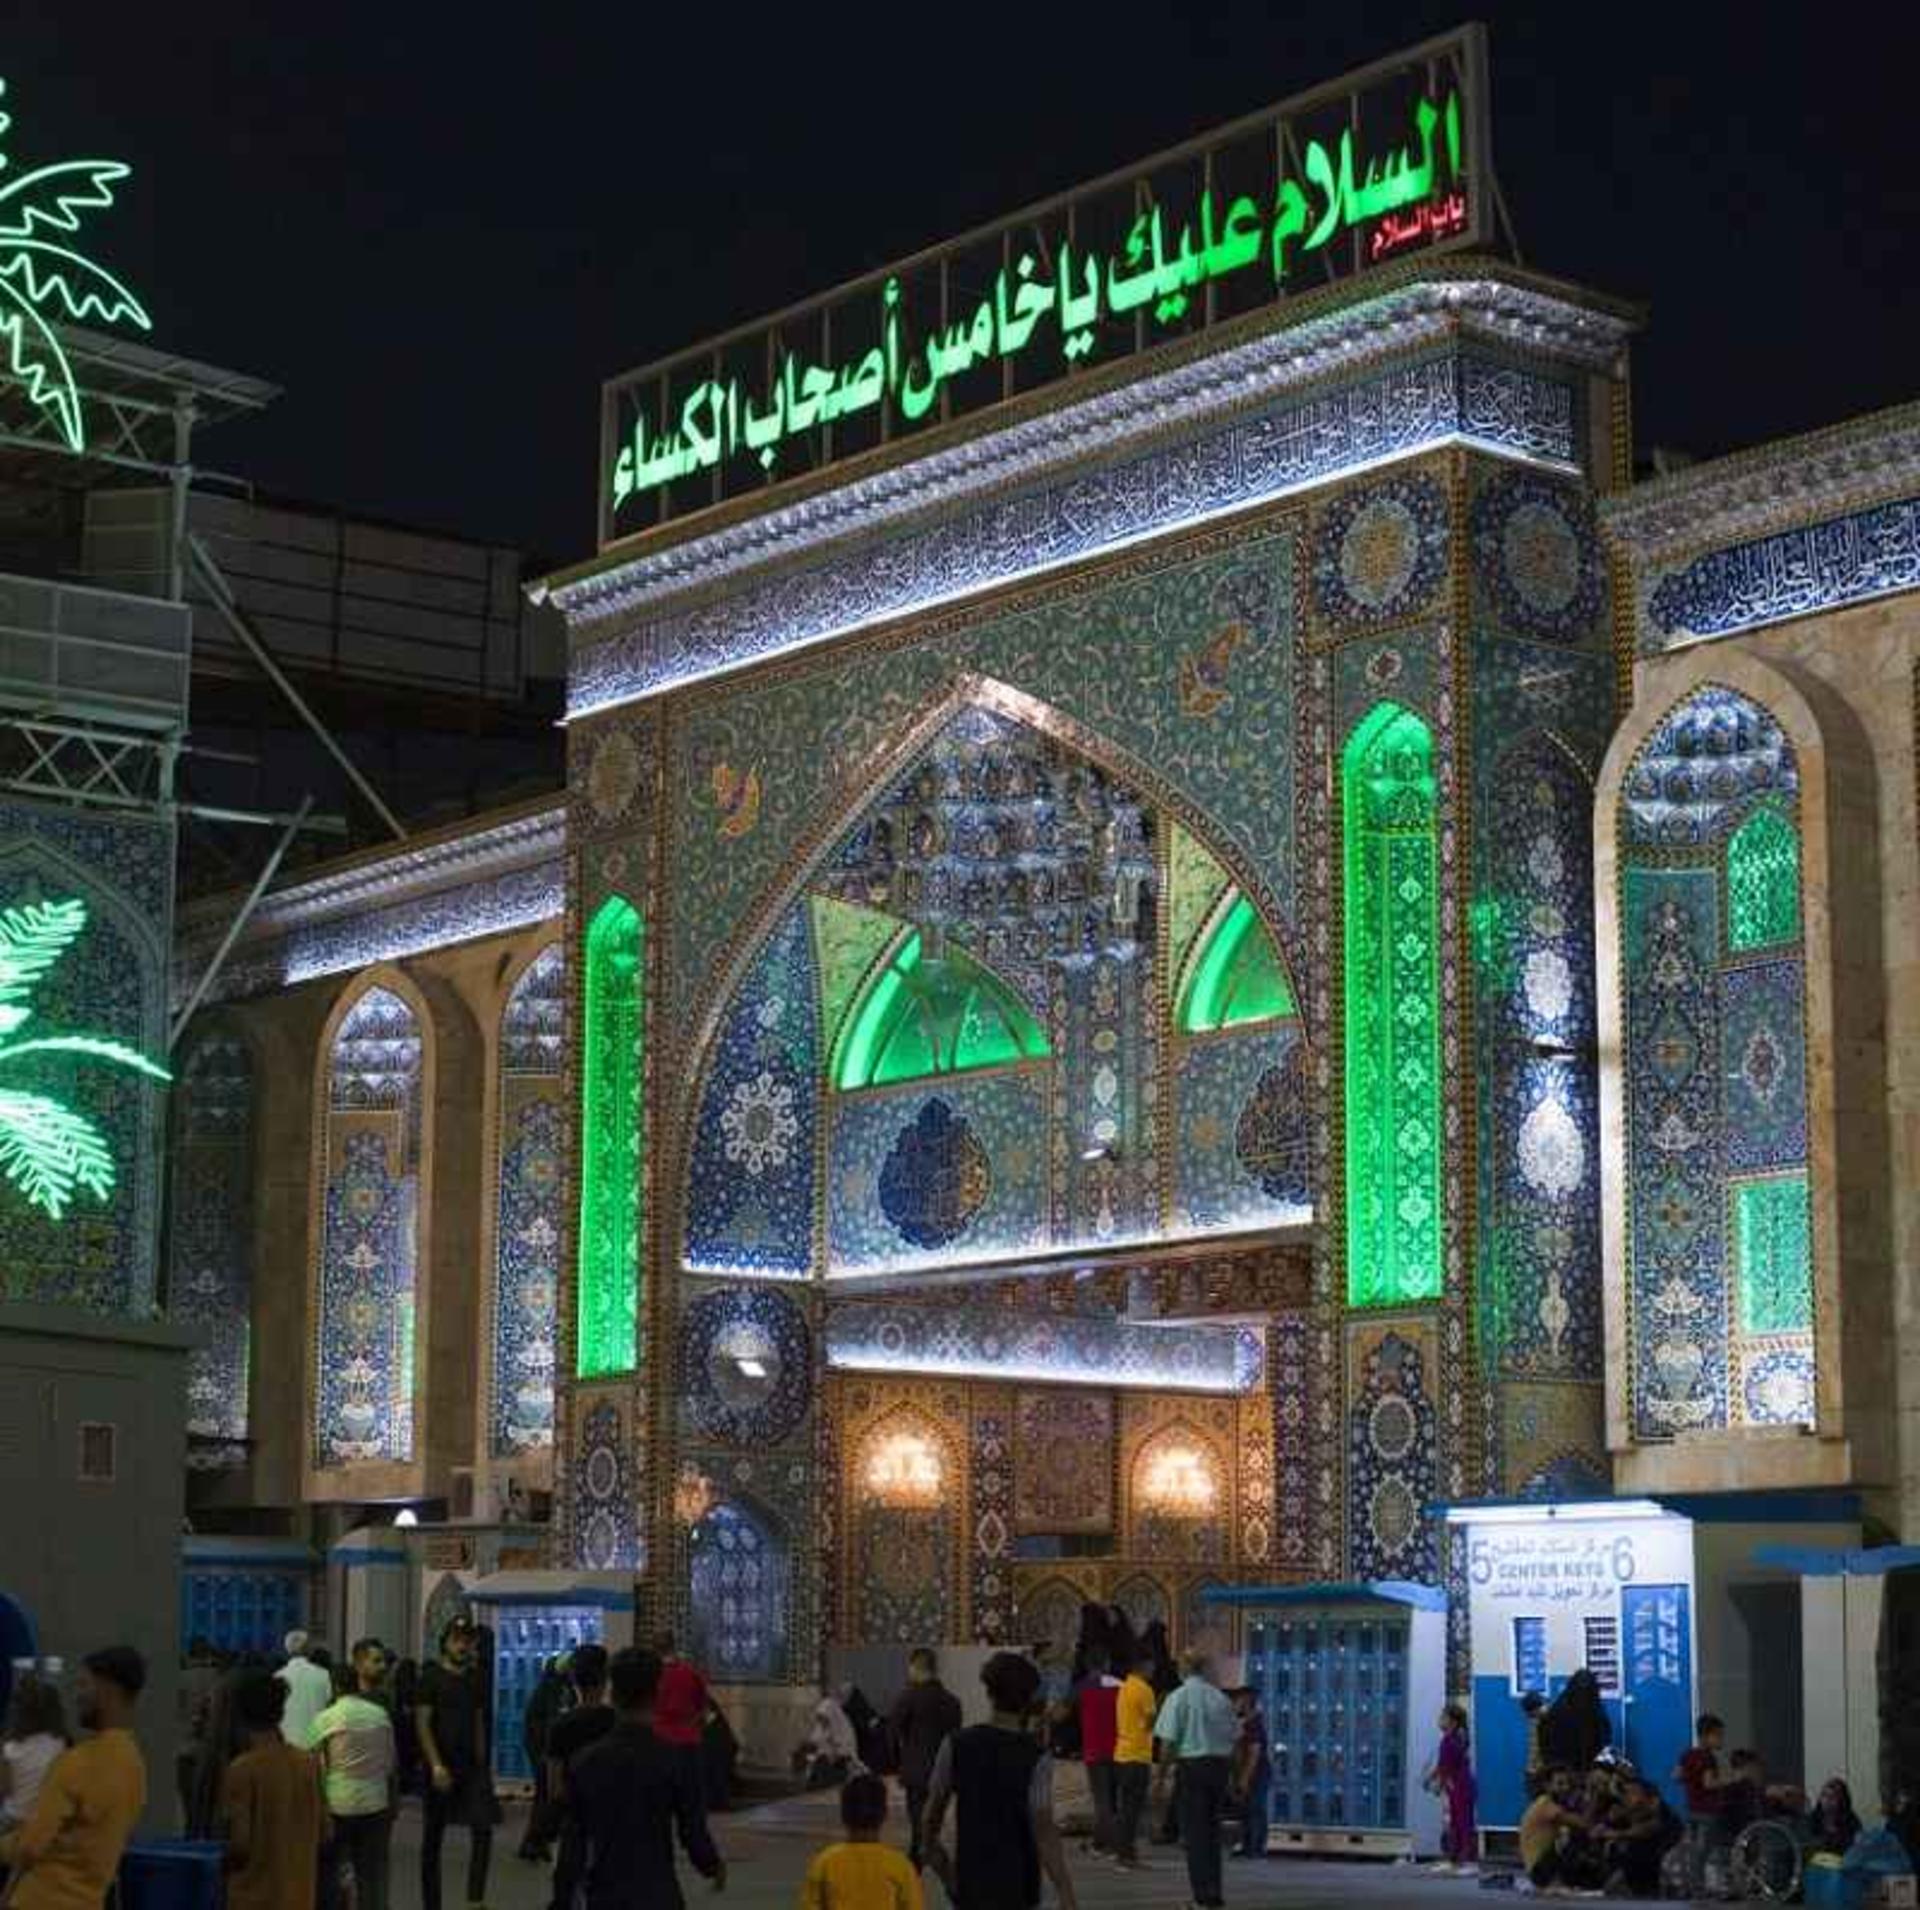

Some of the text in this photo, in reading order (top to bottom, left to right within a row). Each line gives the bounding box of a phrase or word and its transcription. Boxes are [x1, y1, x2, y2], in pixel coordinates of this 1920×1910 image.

[1372, 193, 1464, 259] باب السلام
[613, 92, 1460, 510] السلام عليك يا خامس أصحاب الكساء
[1472, 1539, 1492, 1585] 5
[1498, 1562, 1604, 1579] CENTER KEYS
[1612, 1535, 1635, 1581] 6
